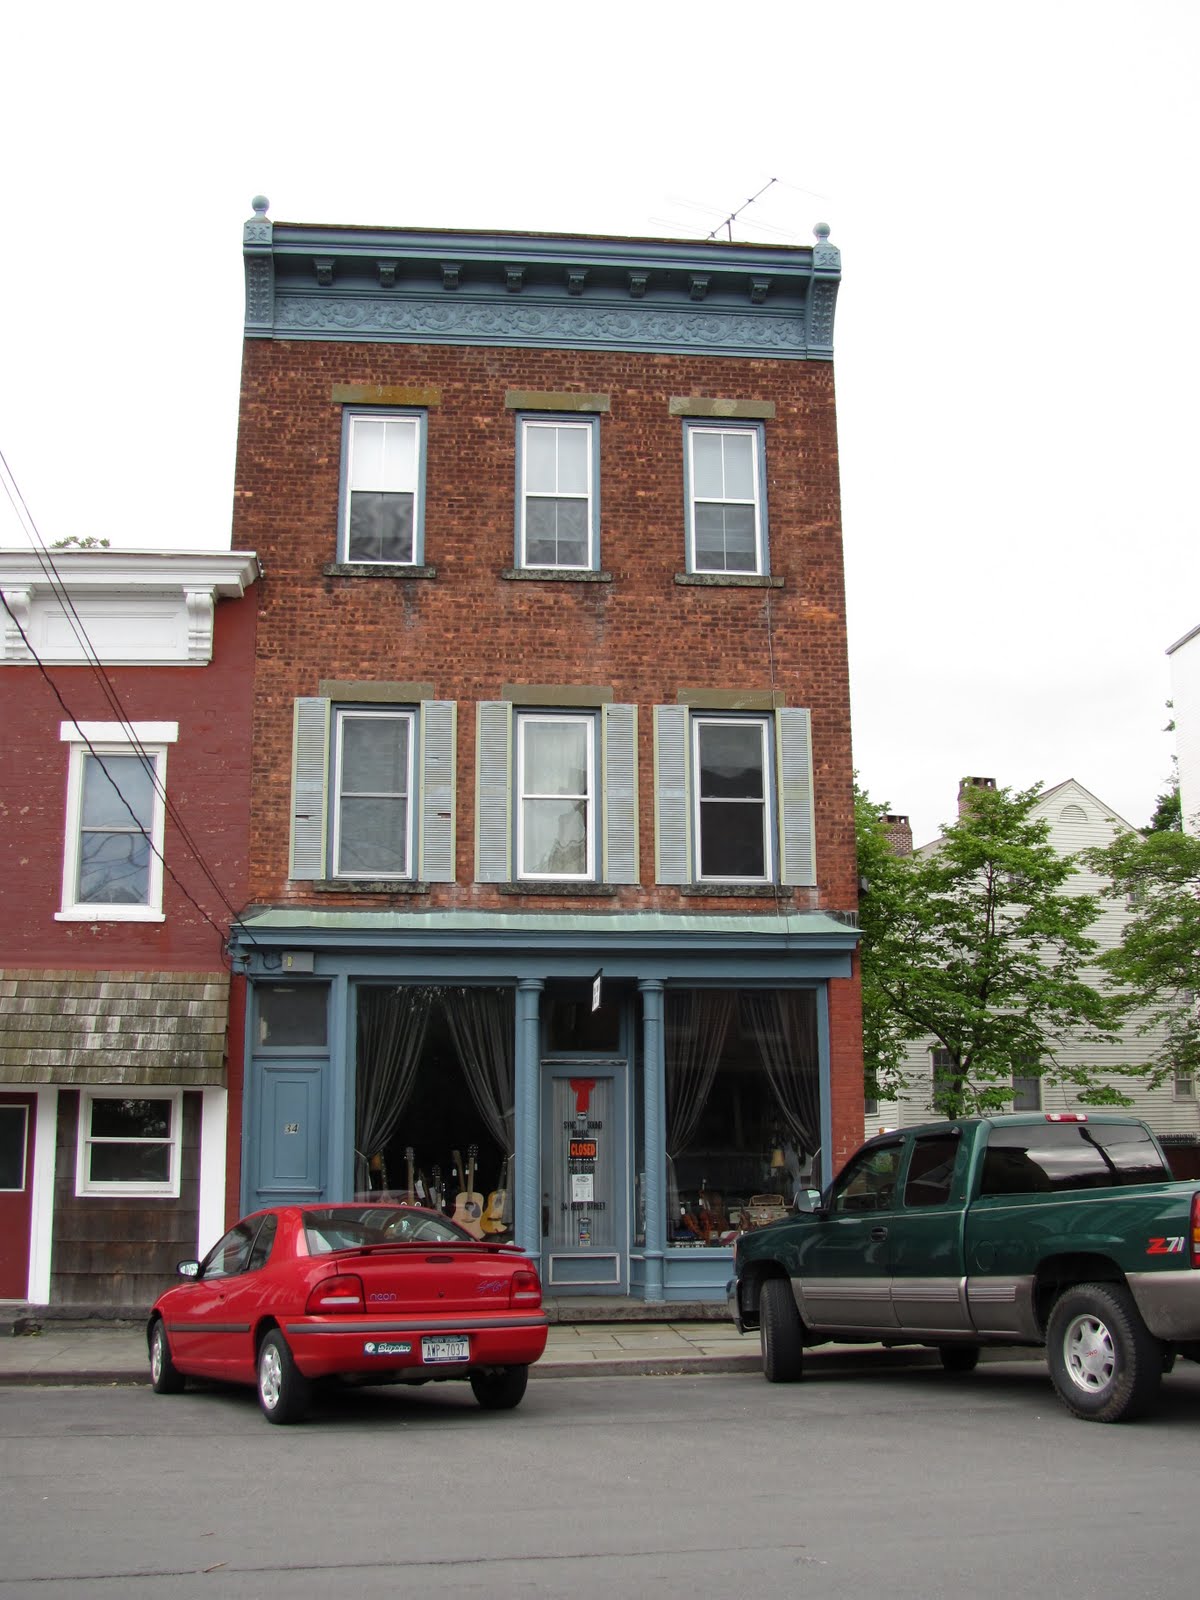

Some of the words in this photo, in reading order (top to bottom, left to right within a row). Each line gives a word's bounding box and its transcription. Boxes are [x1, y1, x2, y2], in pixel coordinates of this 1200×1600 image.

[286, 1123, 299, 1134] 34
[563, 1121, 577, 1129] SYNC
[587, 1121, 602, 1129] SOUND
[570, 1143, 596, 1156] CLOSED
[587, 1202, 606, 1211] STREET
[1146, 1236, 1185, 1254] Z71
[369, 1293, 397, 1301] neon
[427, 1344, 441, 1357] AWP
[446, 1343, 464, 1356] 7037
